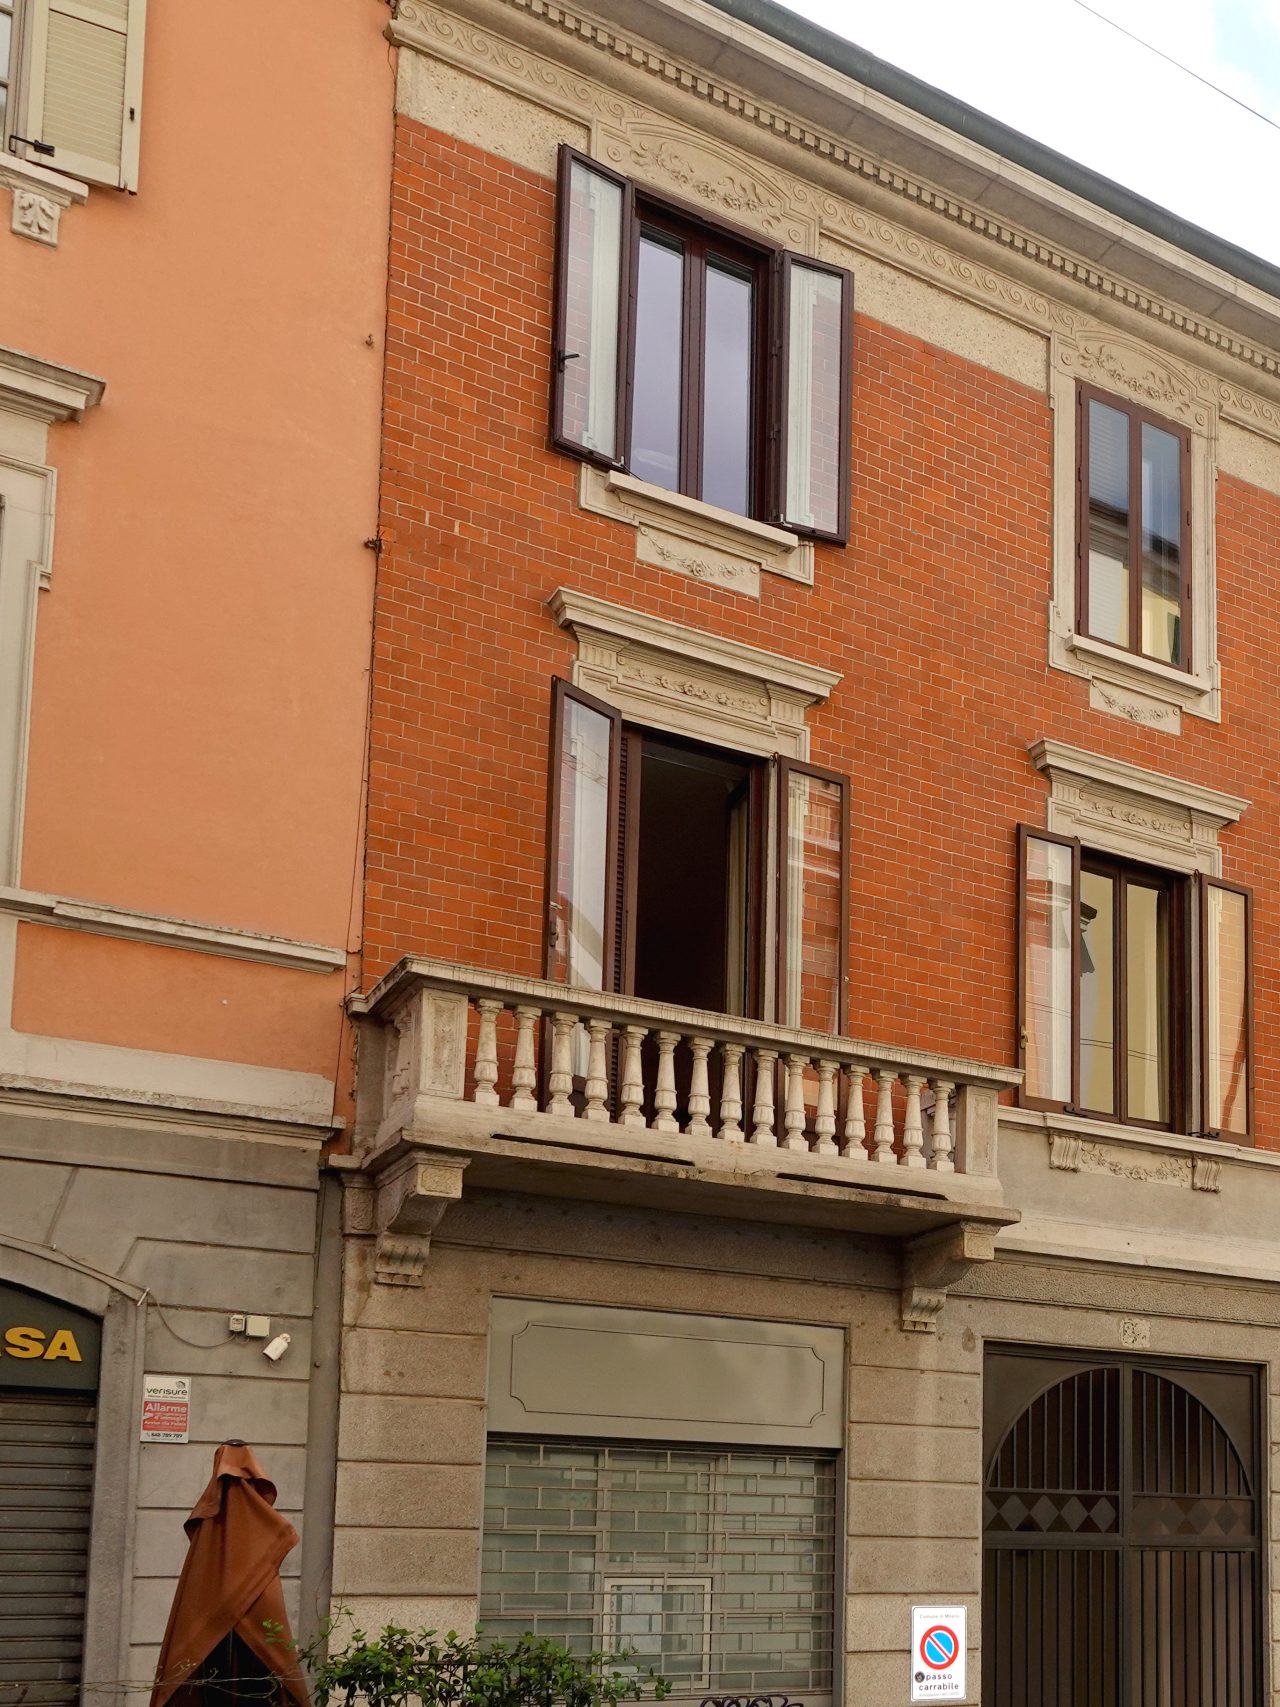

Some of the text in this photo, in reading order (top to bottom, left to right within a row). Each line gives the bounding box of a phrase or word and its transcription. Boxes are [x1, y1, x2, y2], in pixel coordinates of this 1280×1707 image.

[0, 1326, 82, 1362] SA
[145, 1403, 187, 1412] Allarme
[918, 1682, 959, 1691] carrabile
